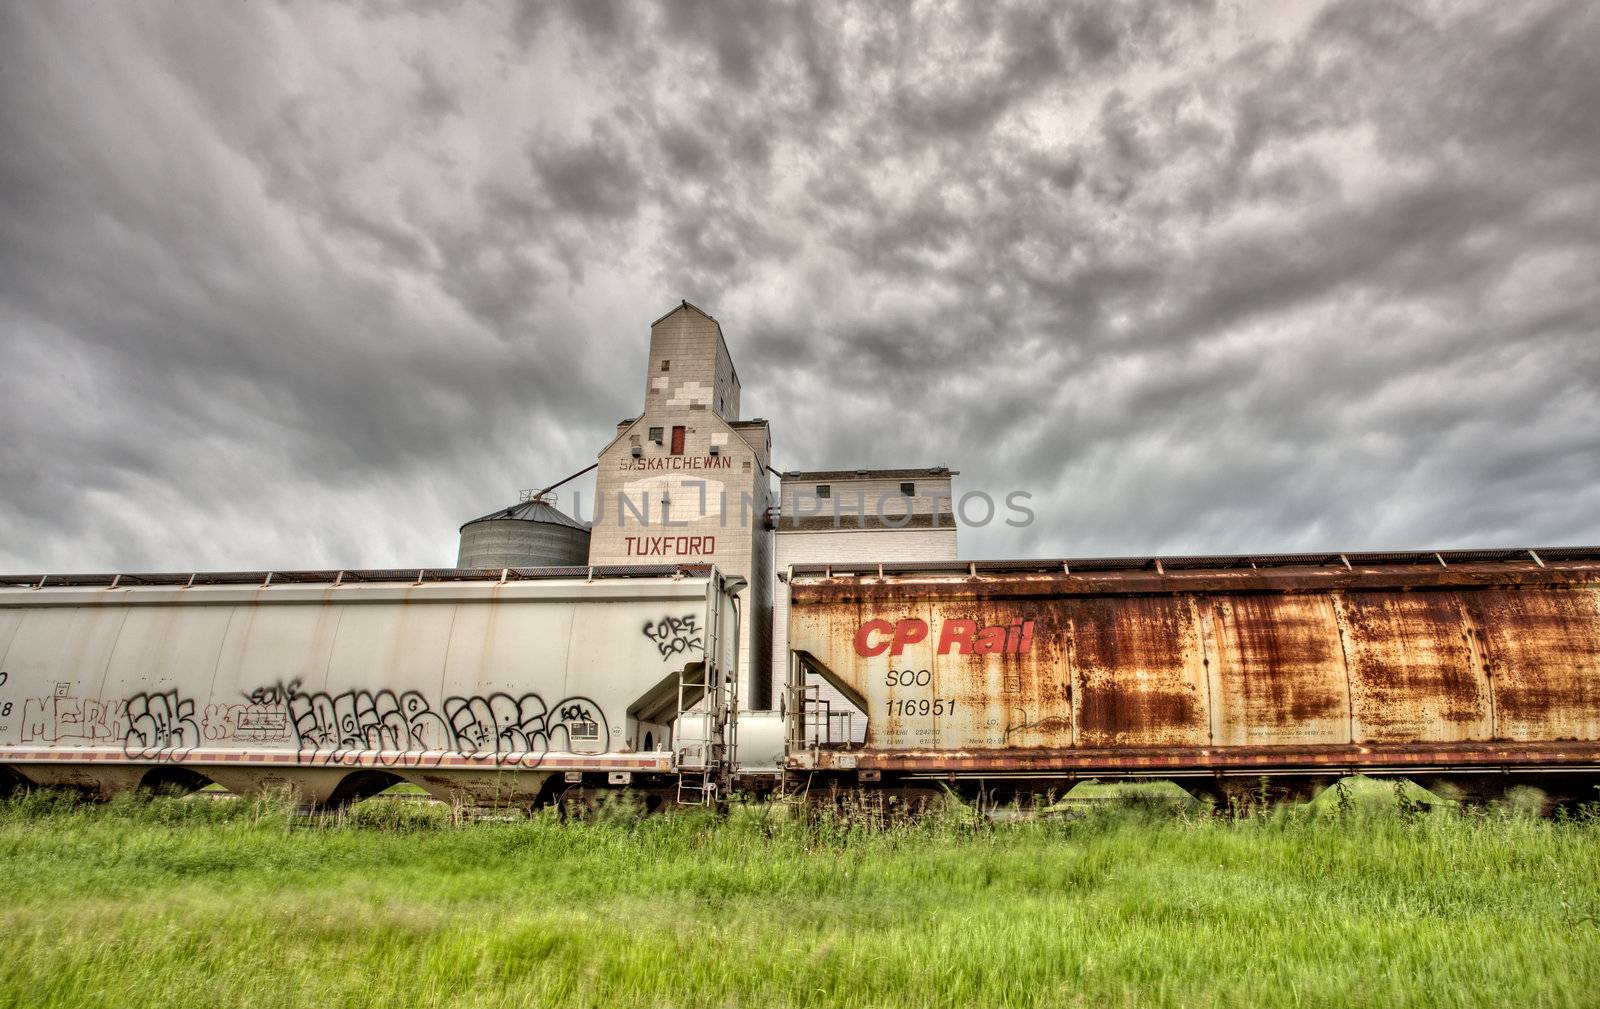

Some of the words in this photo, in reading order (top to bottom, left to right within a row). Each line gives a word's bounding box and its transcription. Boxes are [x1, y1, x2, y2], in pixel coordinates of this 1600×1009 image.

[619, 456, 732, 471] SASKATCHEWAN
[625, 536, 716, 556] TUXFORD
[853, 619, 929, 657] CP
[937, 617, 1035, 655] Rail
[885, 669, 932, 687] SOO
[886, 699, 956, 716] 116951
